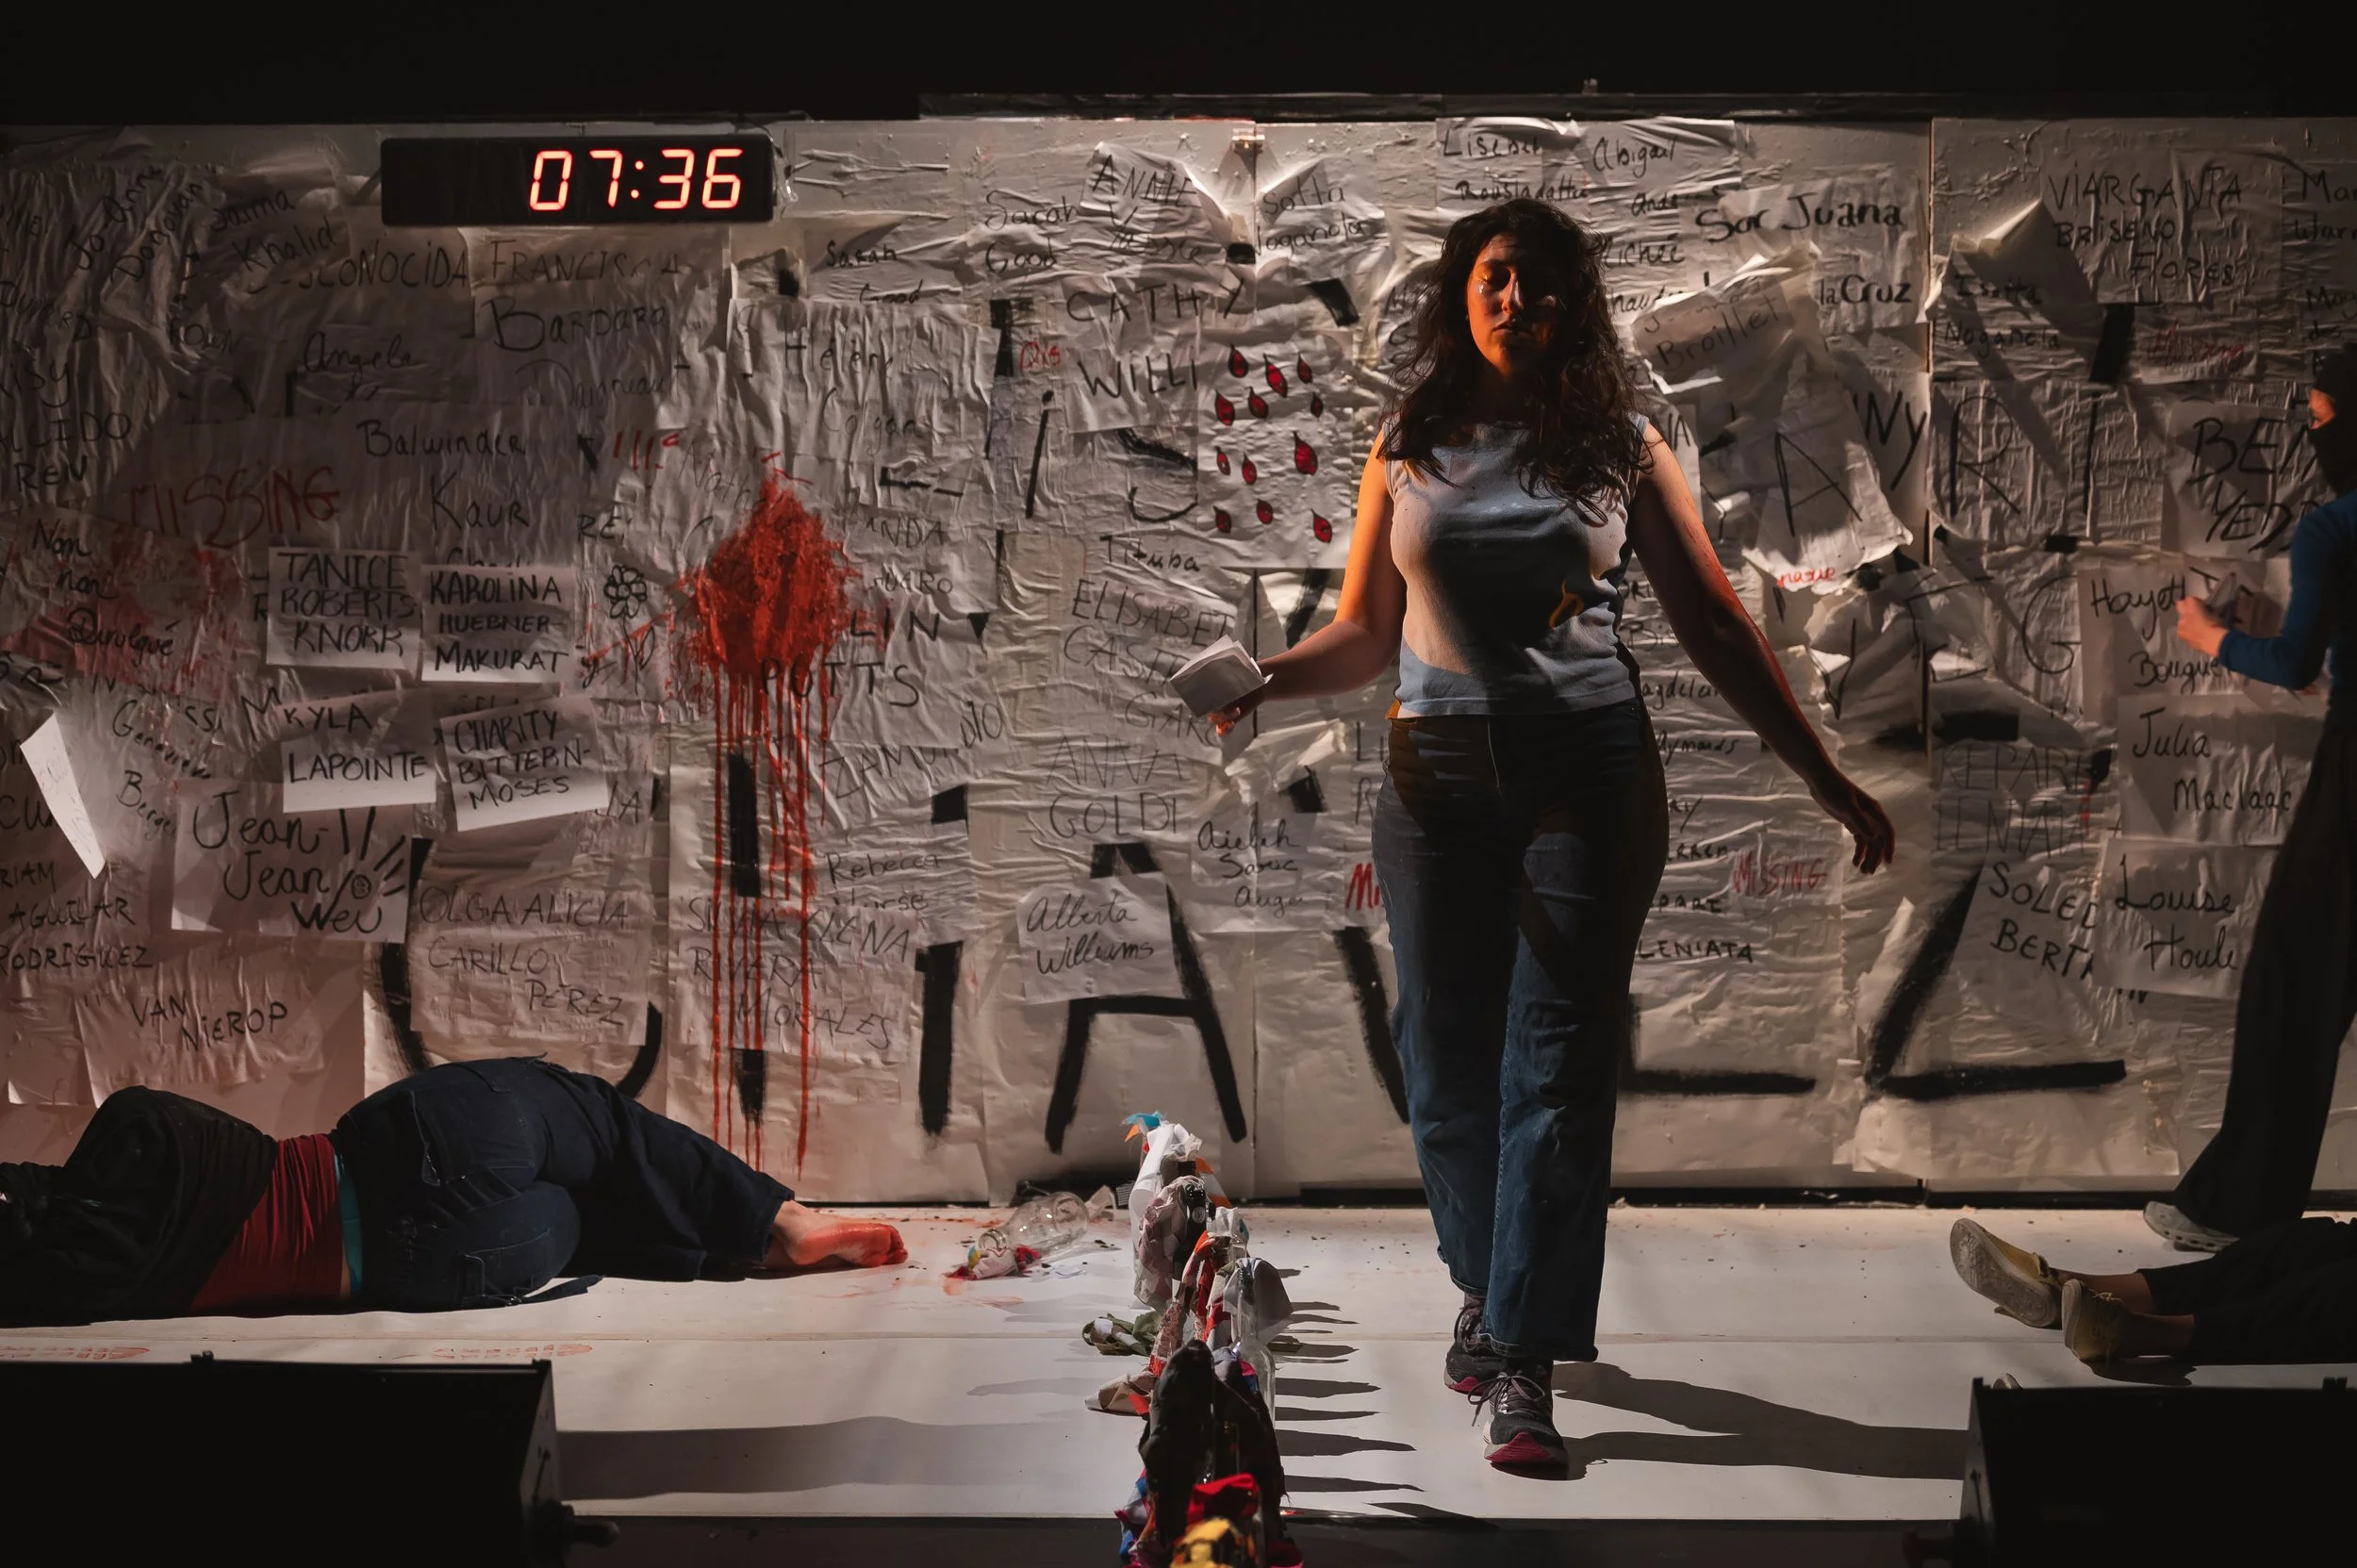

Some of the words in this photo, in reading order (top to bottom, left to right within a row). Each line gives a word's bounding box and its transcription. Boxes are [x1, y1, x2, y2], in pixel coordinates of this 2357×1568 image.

[529, 147, 745, 212] 07:36
[1781, 192, 1906, 232] Juana
[1839, 273, 1914, 306] Cruz
[284, 703, 373, 734] KYLA
[453, 709, 558, 755] CHARITY
[2133, 707, 2211, 758] Julia
[288, 751, 430, 784] LAPOINTE
[468, 775, 570, 810] MOSES
